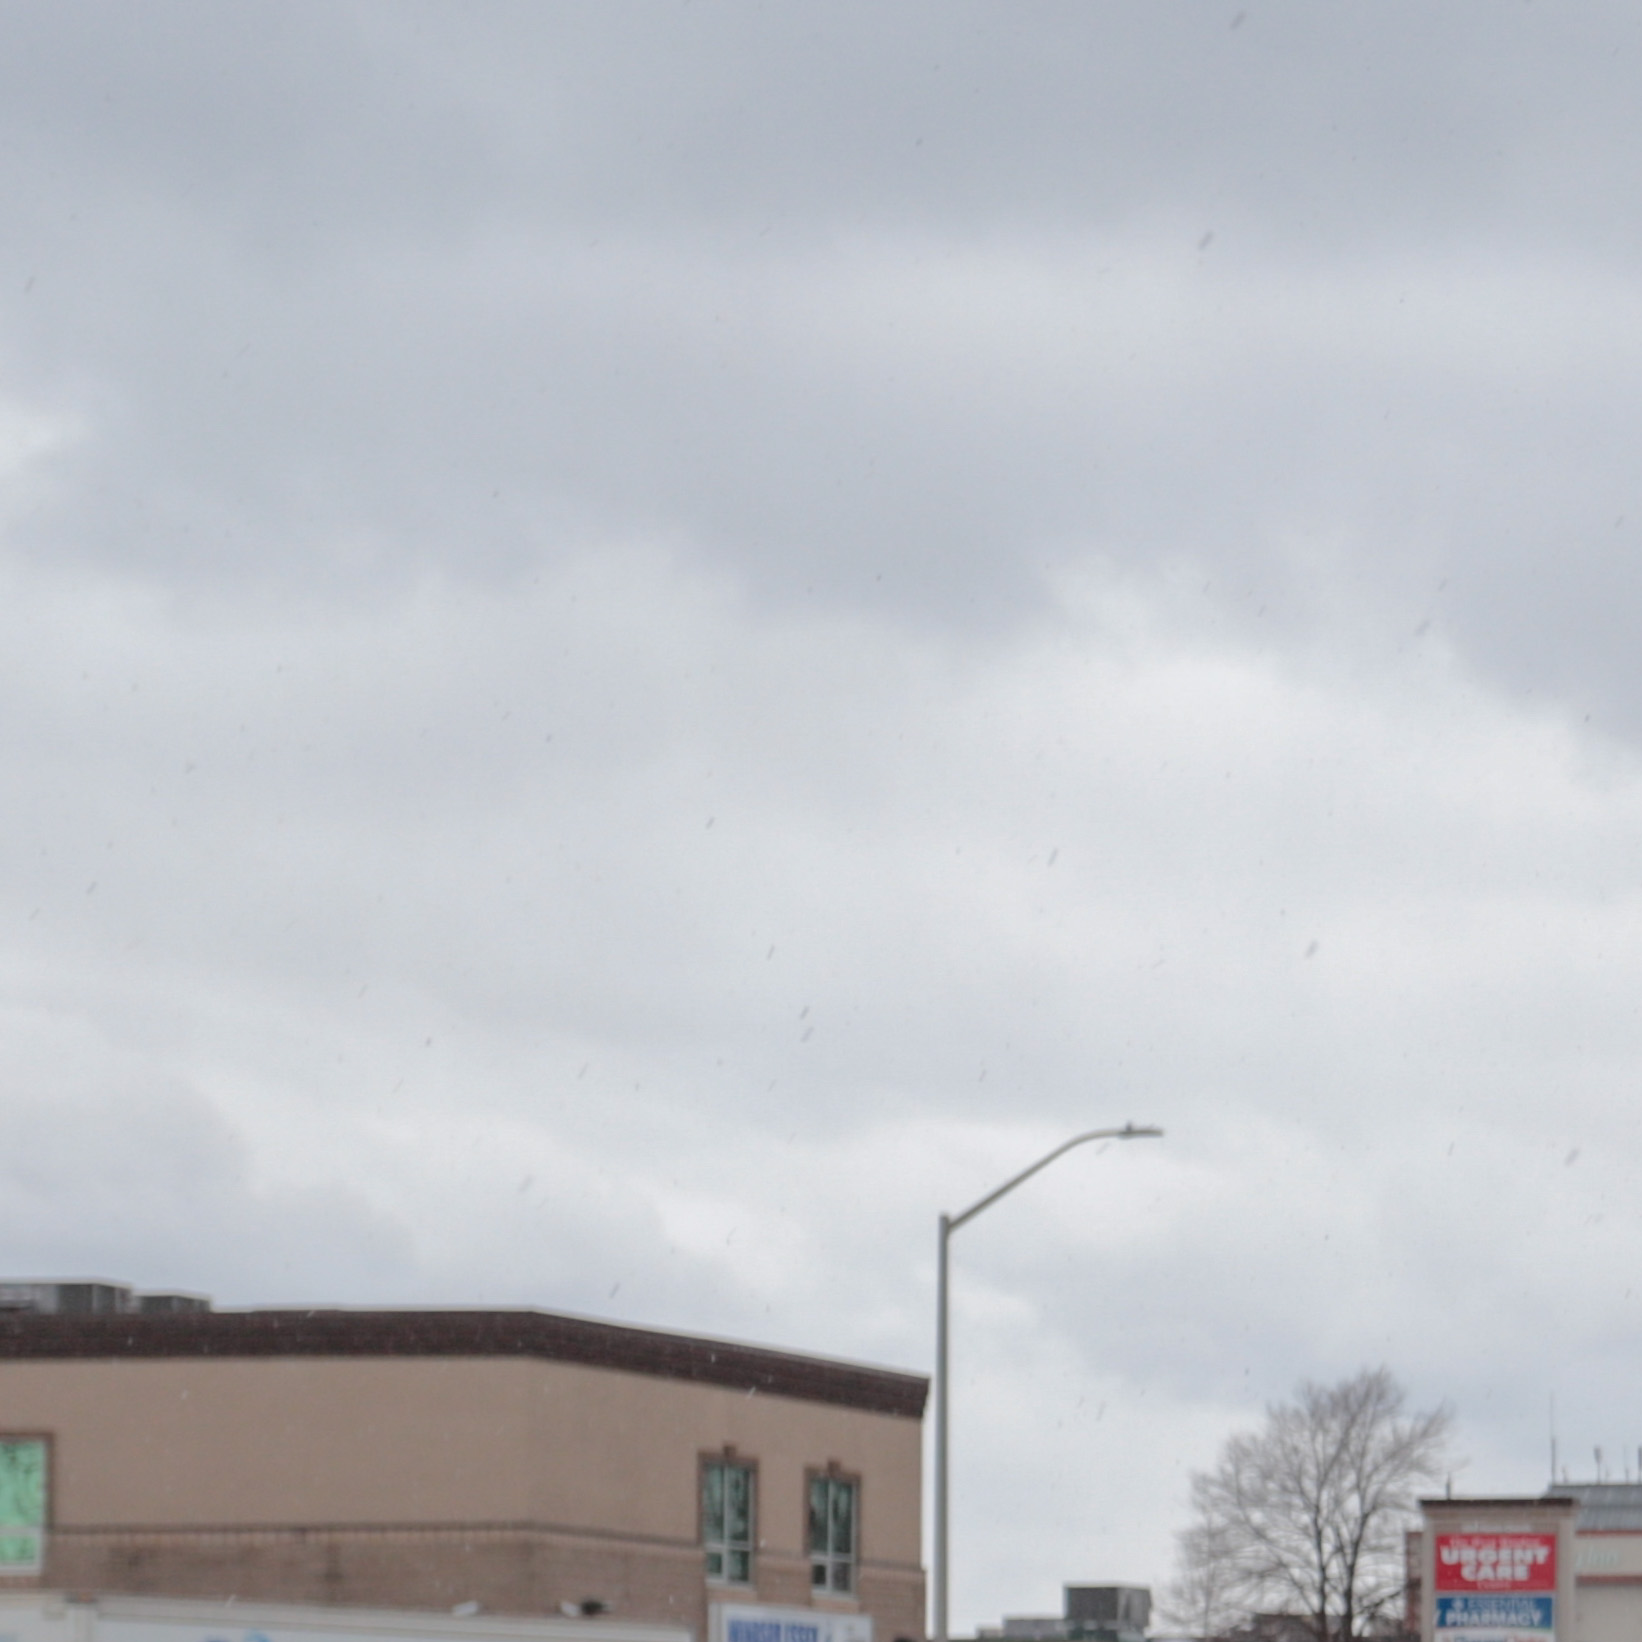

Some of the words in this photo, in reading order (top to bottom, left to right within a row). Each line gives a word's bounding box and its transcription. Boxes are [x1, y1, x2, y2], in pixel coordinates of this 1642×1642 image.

[1440, 1545, 1549, 1565] URGENT
[1460, 1563, 1531, 1581] CARE
[1445, 1611, 1543, 1627] PHARMACY
